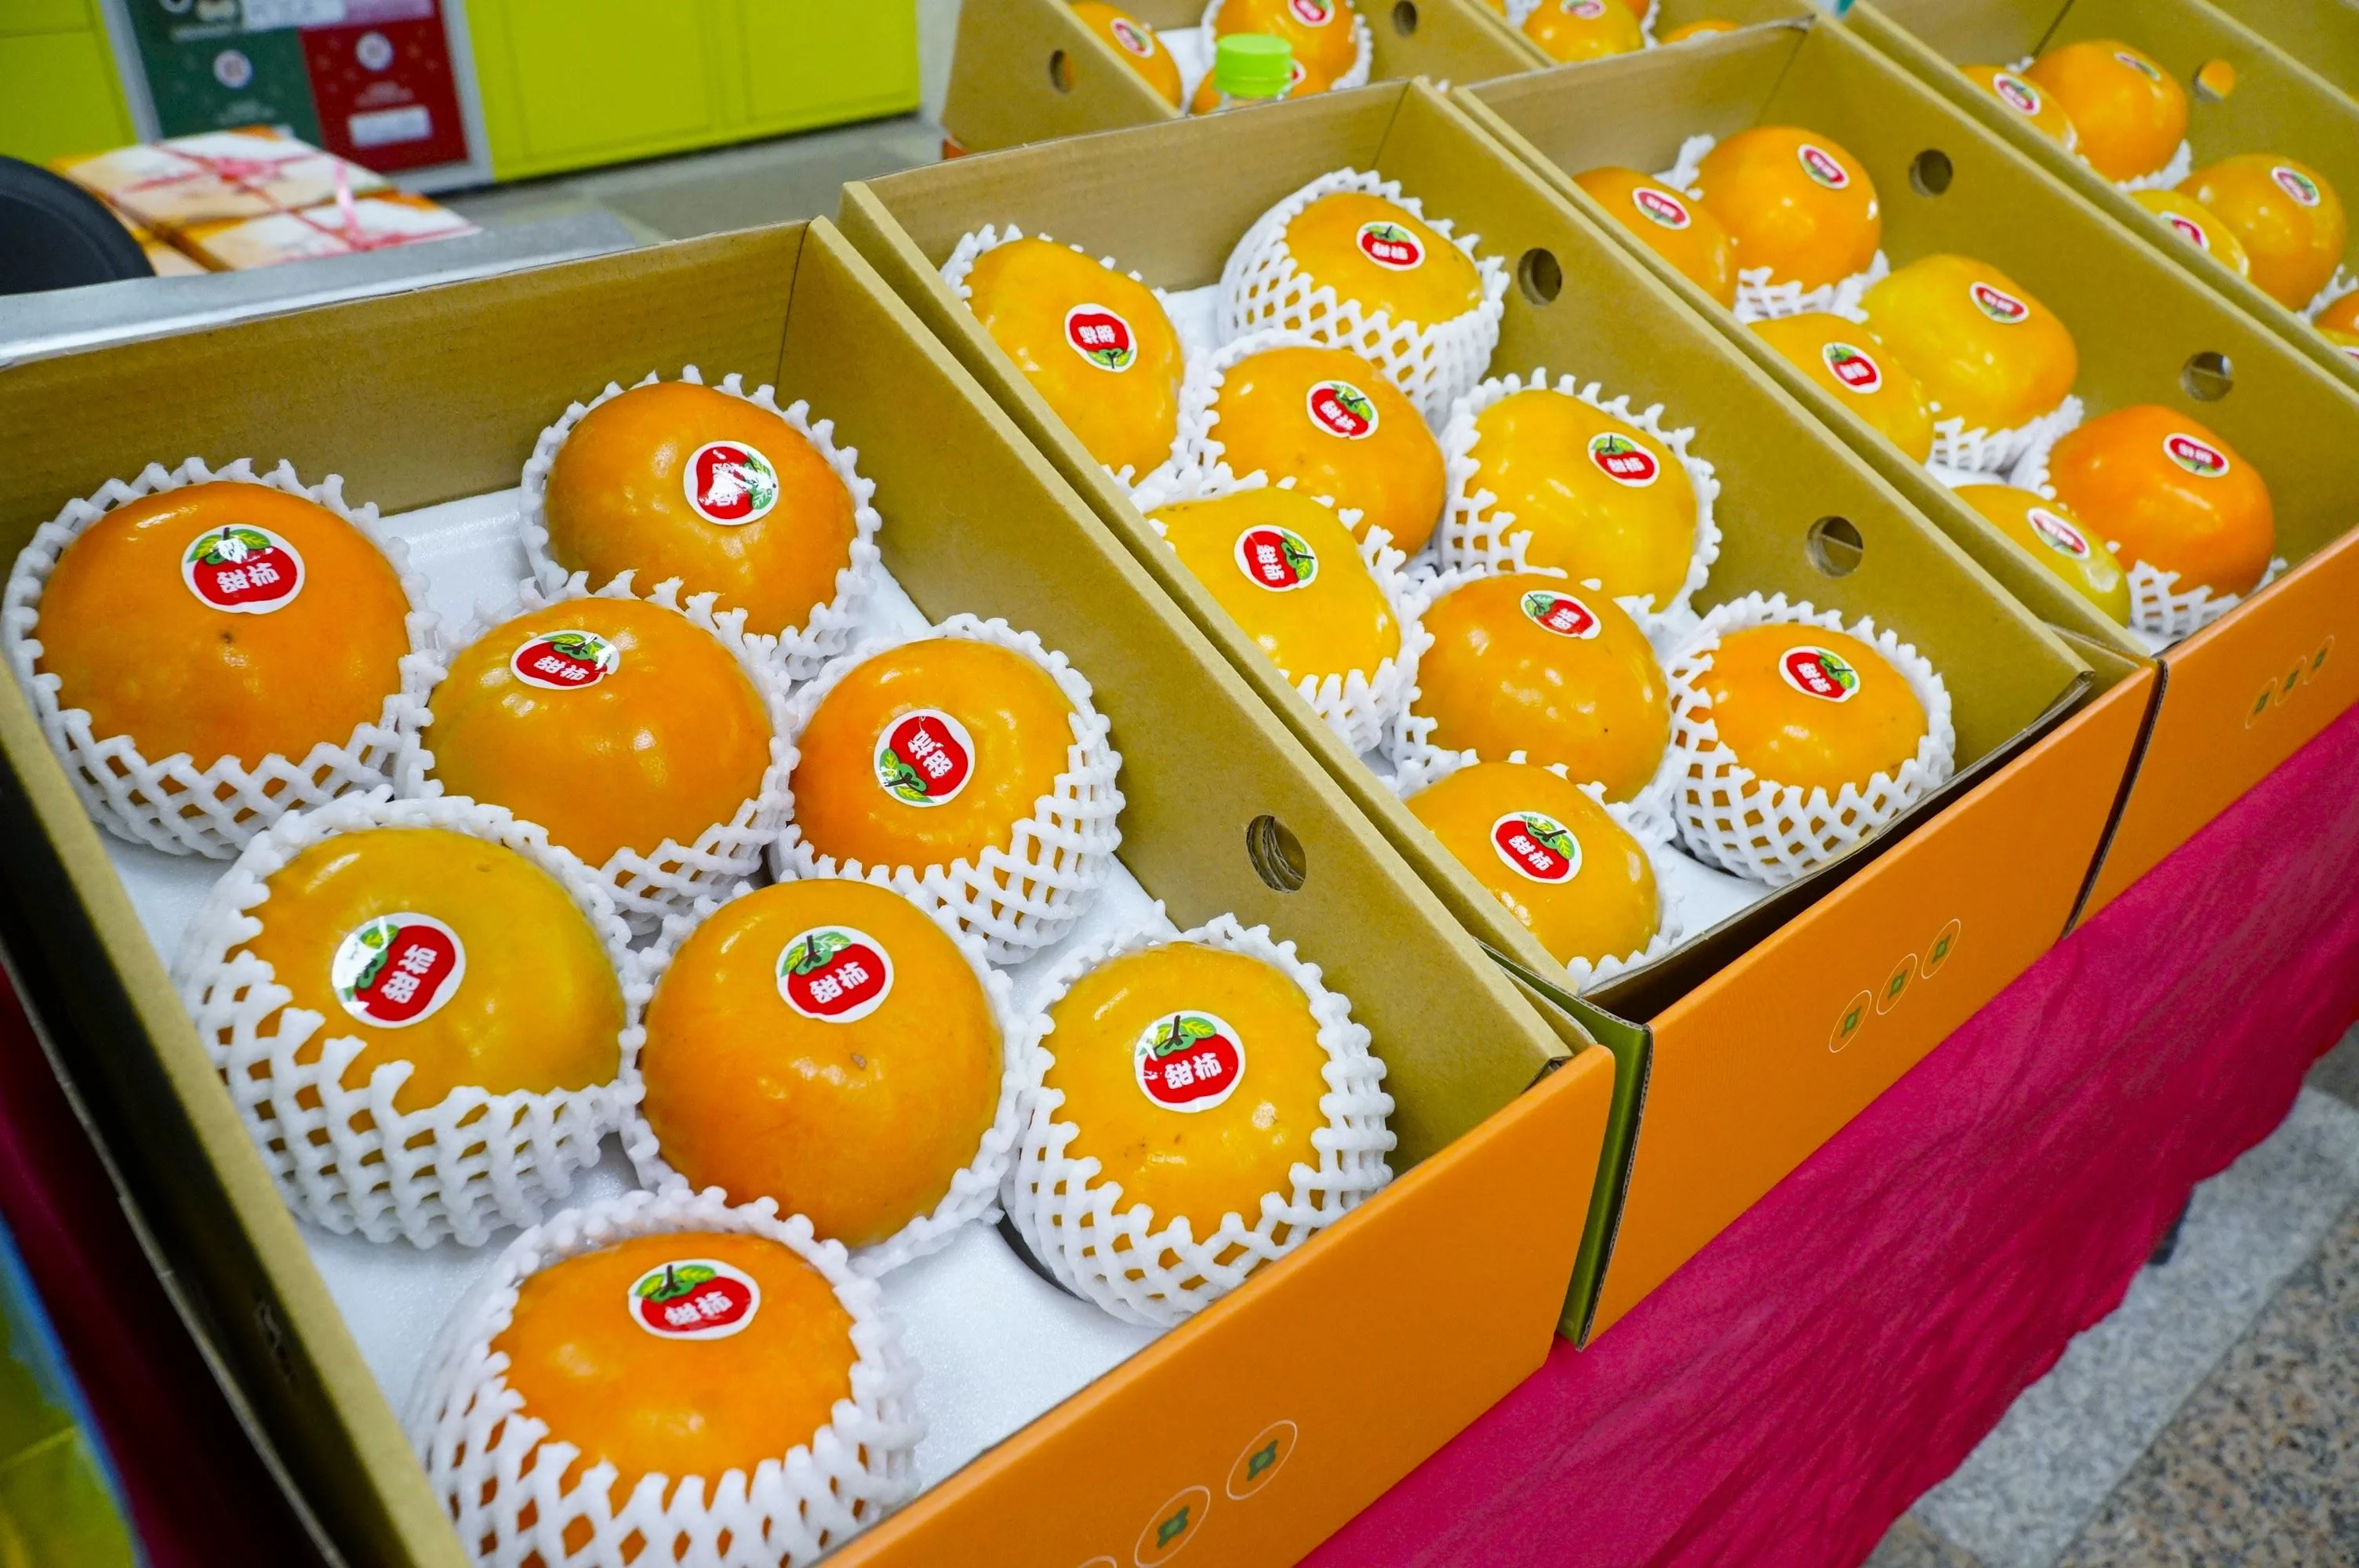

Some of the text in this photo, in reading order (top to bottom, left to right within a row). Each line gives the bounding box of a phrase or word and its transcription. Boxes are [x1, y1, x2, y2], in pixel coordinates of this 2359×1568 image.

[217, 562, 279, 593] 甜柿
[534, 655, 588, 681] 甜柿
[908, 731, 954, 779] 甜柿
[1509, 834, 1553, 870] 甜柿
[380, 944, 438, 1004] 甜柿
[809, 961, 869, 1003] 甜柿
[1165, 1052, 1222, 1089] 甜柿
[664, 1291, 733, 1325] 甜柿
